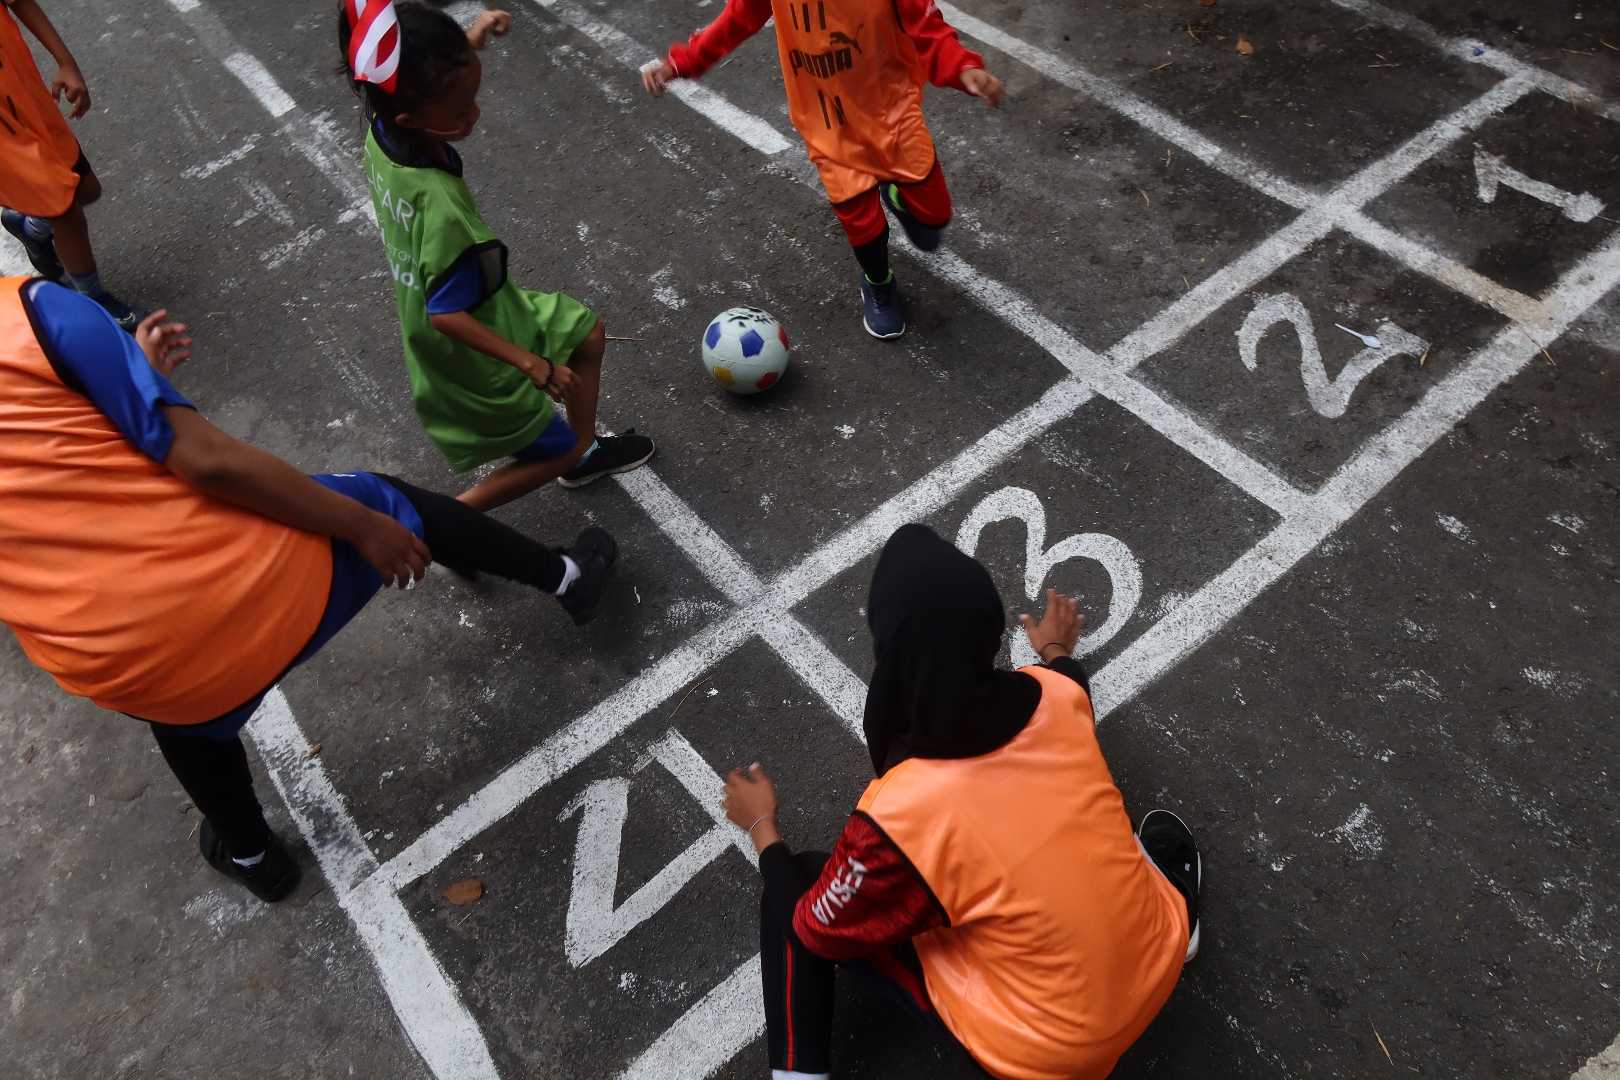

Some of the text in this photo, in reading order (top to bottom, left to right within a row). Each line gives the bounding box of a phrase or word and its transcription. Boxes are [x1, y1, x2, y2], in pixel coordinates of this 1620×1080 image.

[788, 47, 852, 81] PUMA
[1473, 142, 1605, 223] 1
[1235, 291, 1430, 419] 2
[955, 486, 1143, 673] 3
[558, 727, 762, 967] 4
